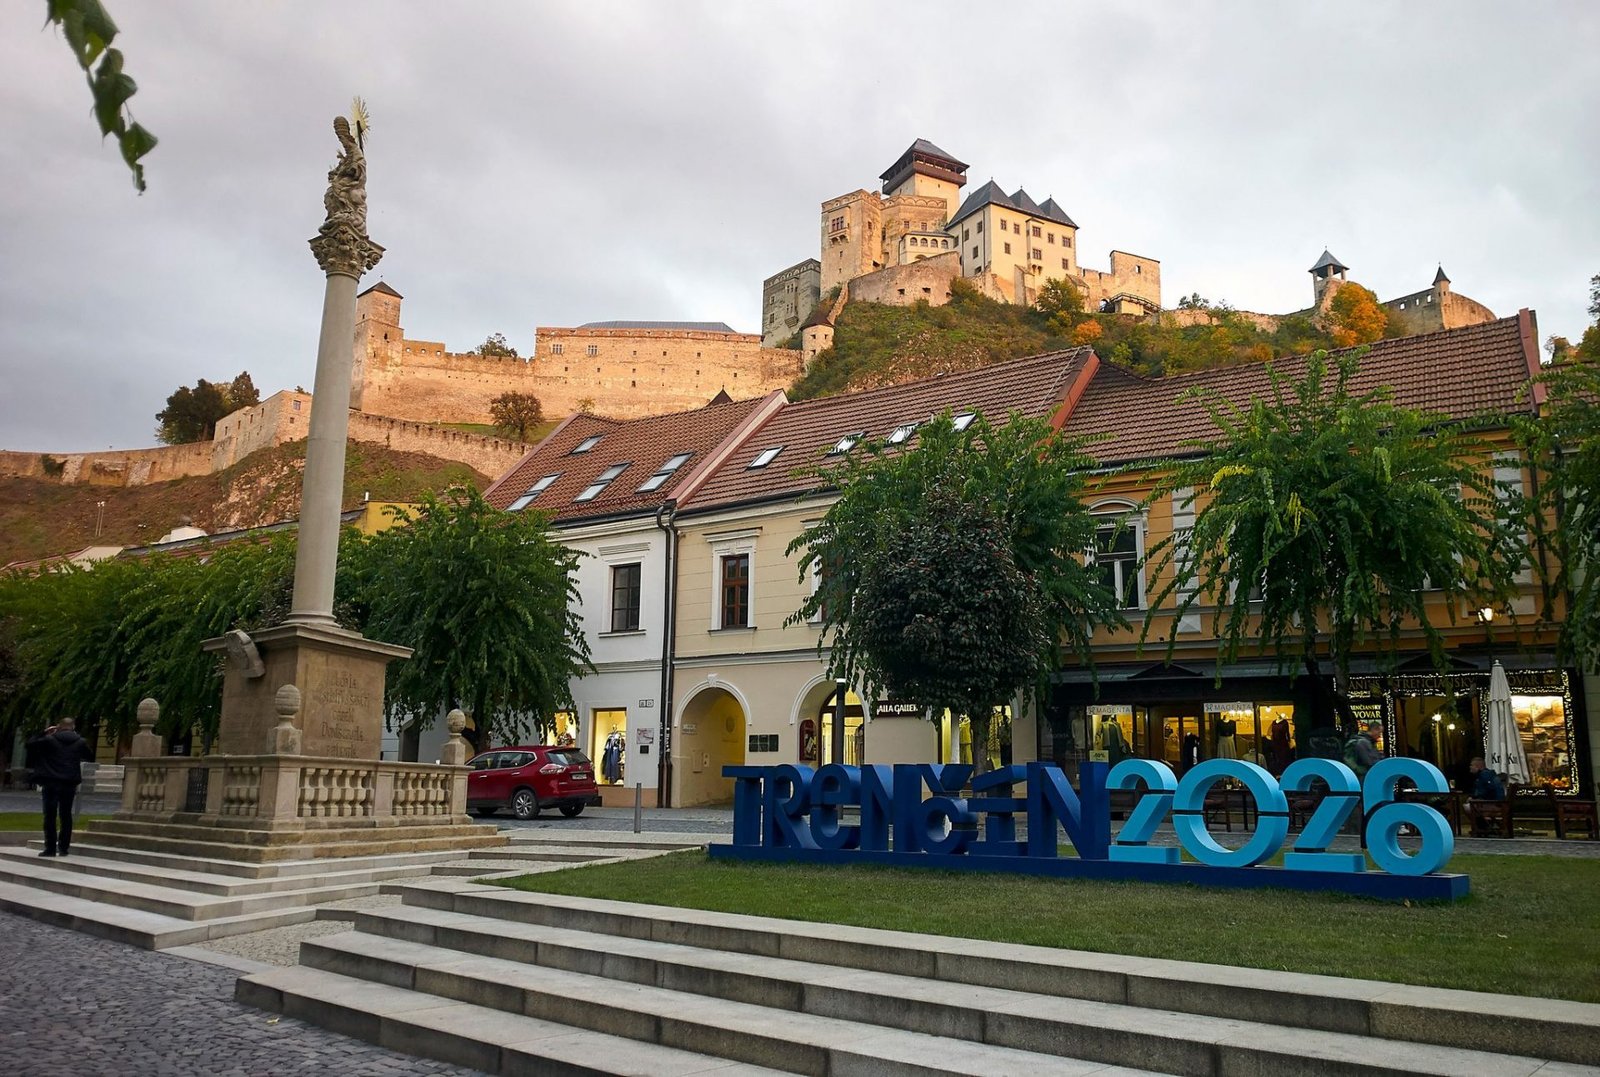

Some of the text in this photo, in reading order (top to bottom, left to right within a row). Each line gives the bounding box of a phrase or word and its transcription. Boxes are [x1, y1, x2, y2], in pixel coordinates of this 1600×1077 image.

[894, 704, 922, 715] GALLER
[1097, 706, 1131, 714] MAGENTA
[1214, 703, 1252, 711] MAGENTA
[1105, 757, 1455, 876] 2026
